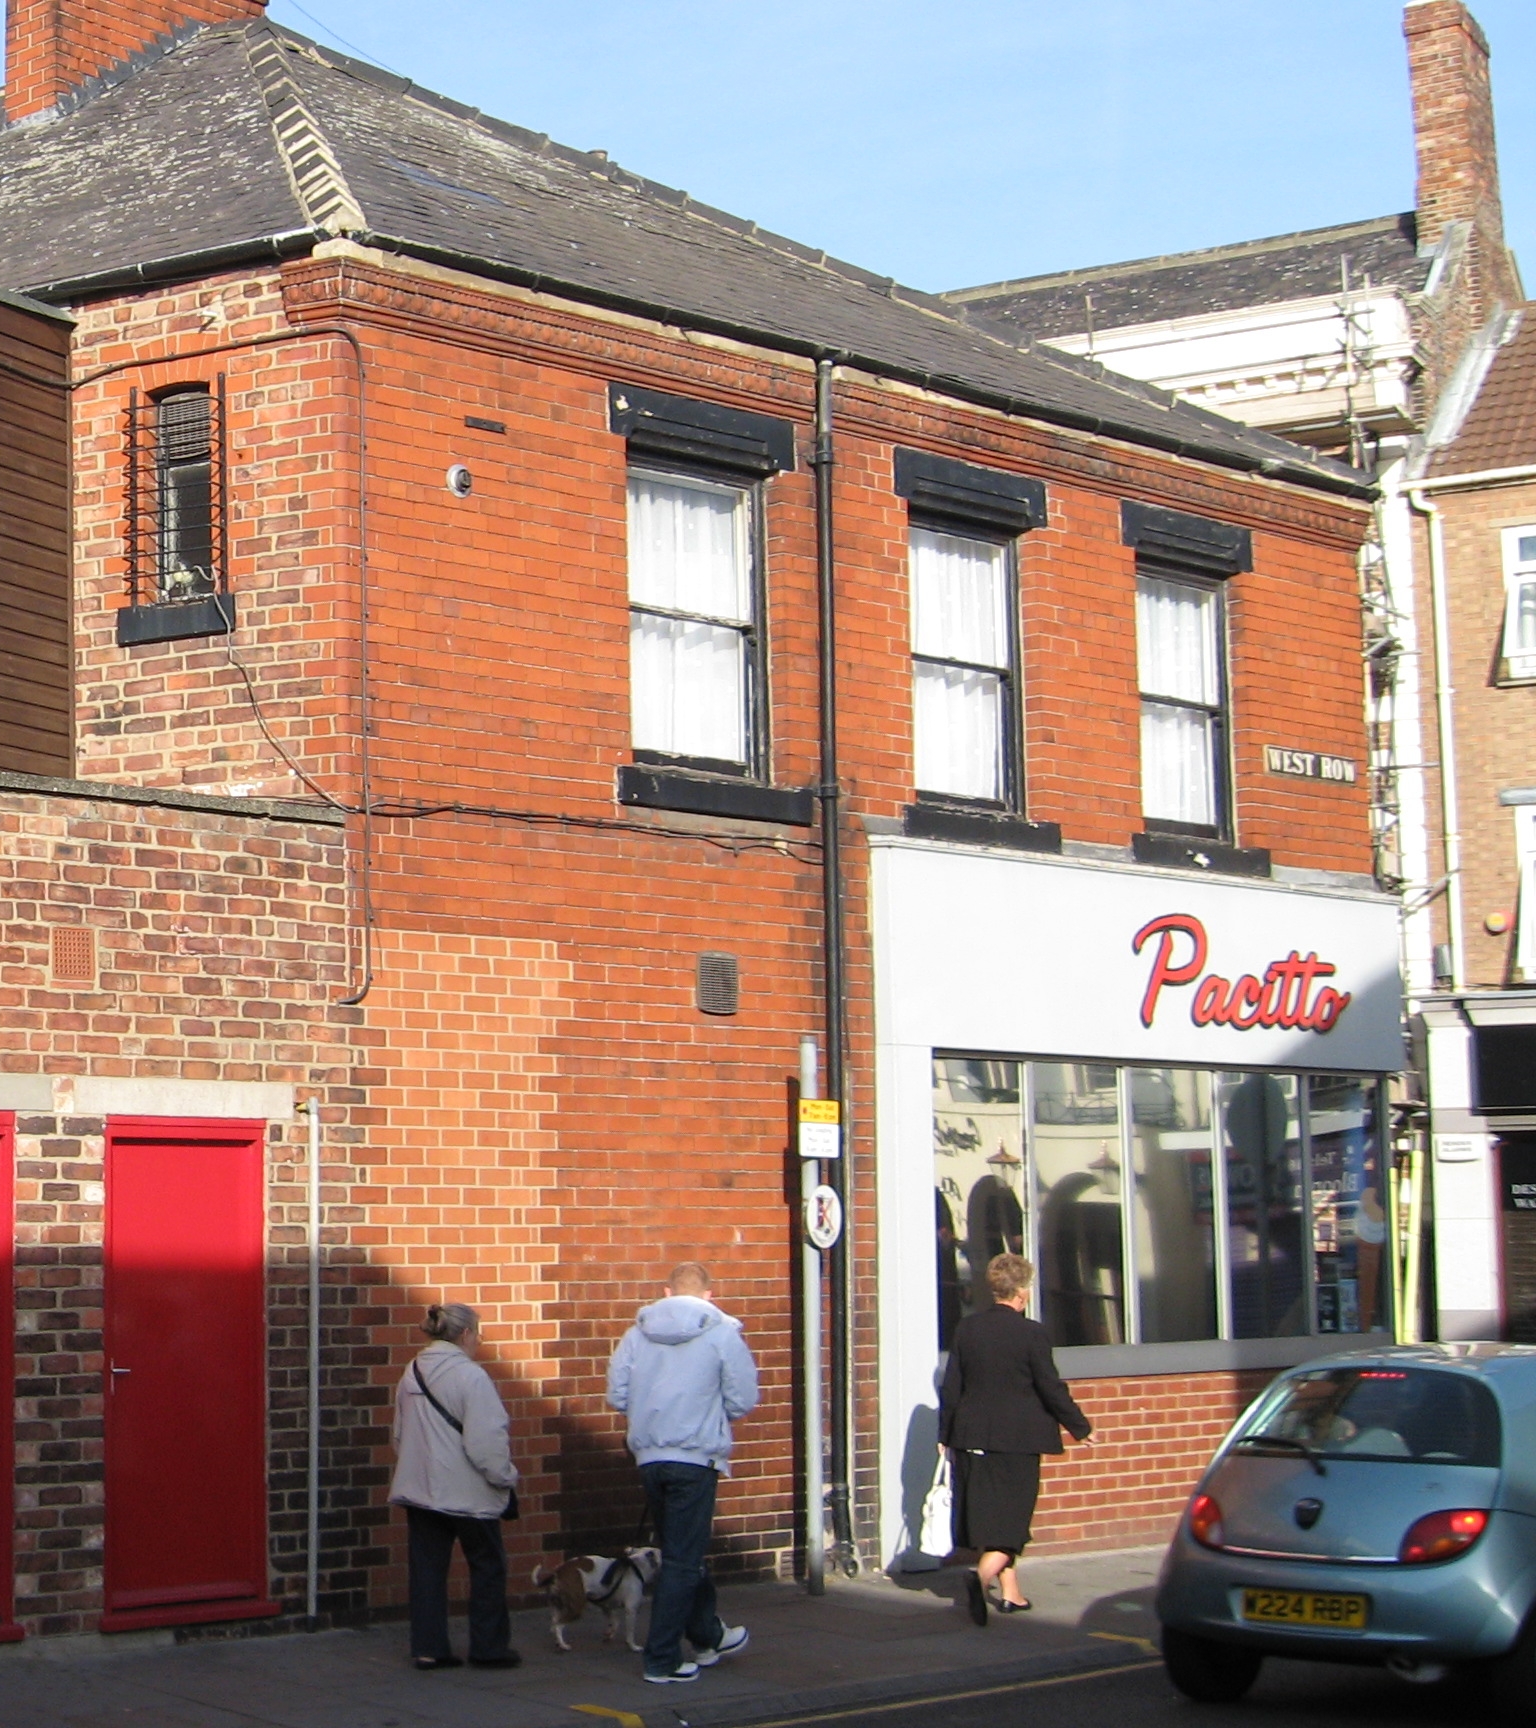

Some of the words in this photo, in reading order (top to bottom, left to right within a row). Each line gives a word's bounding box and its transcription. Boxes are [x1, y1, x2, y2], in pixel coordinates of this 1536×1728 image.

[1267, 748, 1315, 776] WEST
[1320, 756, 1357, 782] ROW
[1131, 912, 1352, 1035] Pacitto
[1312, 1597, 1361, 1622] RBP
